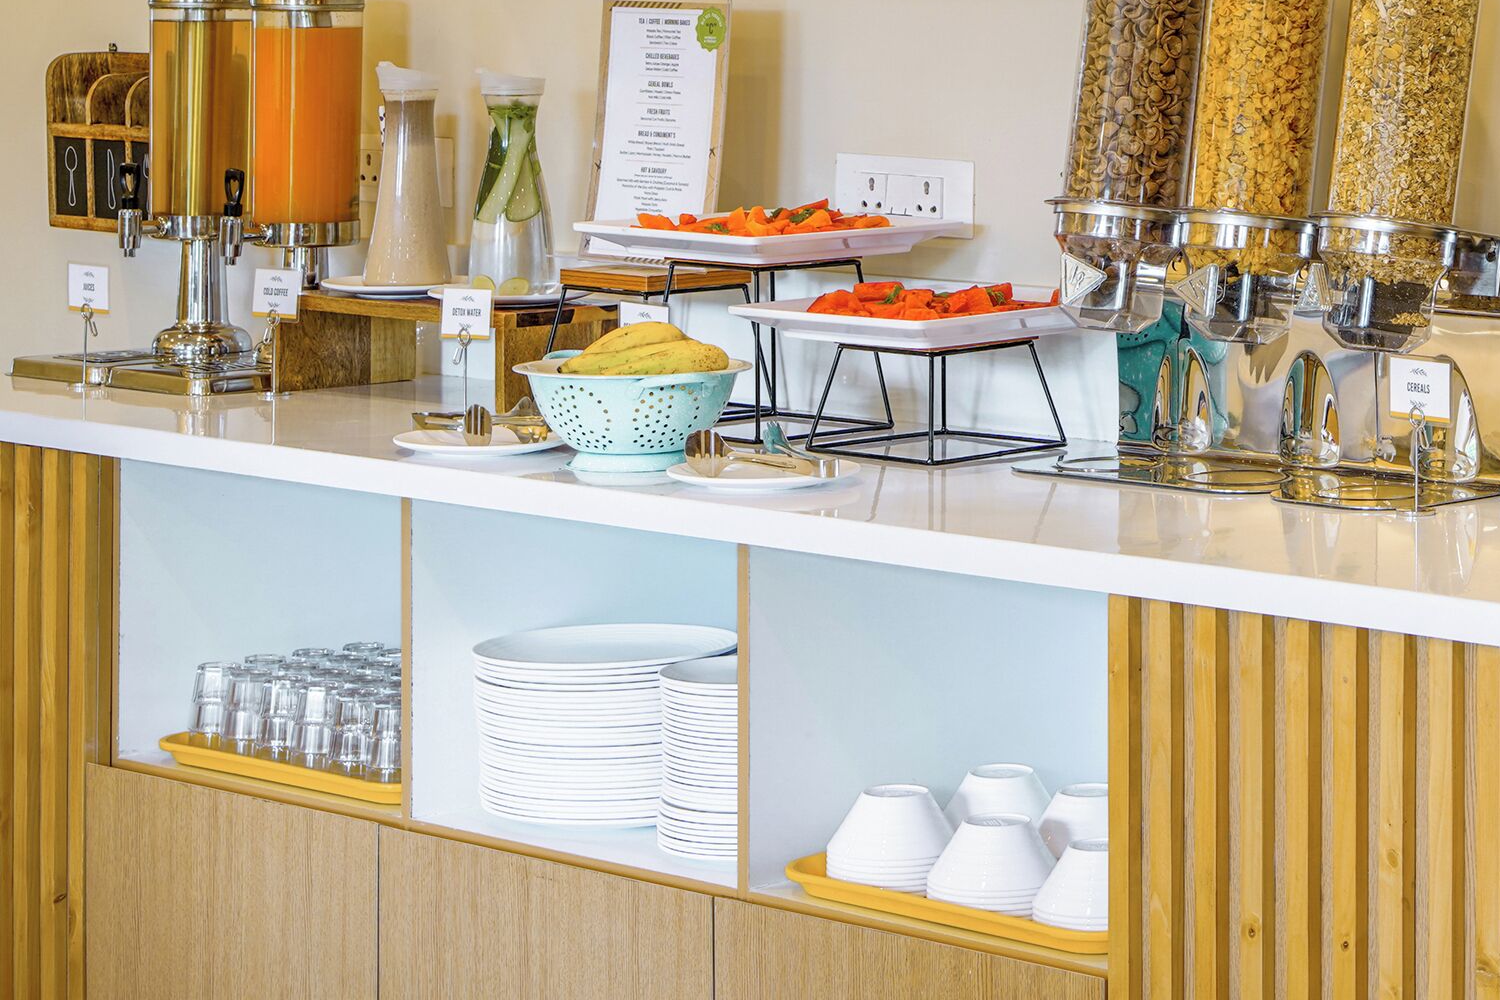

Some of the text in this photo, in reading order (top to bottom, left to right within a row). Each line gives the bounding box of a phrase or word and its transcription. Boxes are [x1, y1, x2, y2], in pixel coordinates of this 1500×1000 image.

[263, 287, 289, 296] COLD COFFEE
[452, 307, 481, 317] DETOX WATER
[1406, 382, 1430, 394] CEREALS
